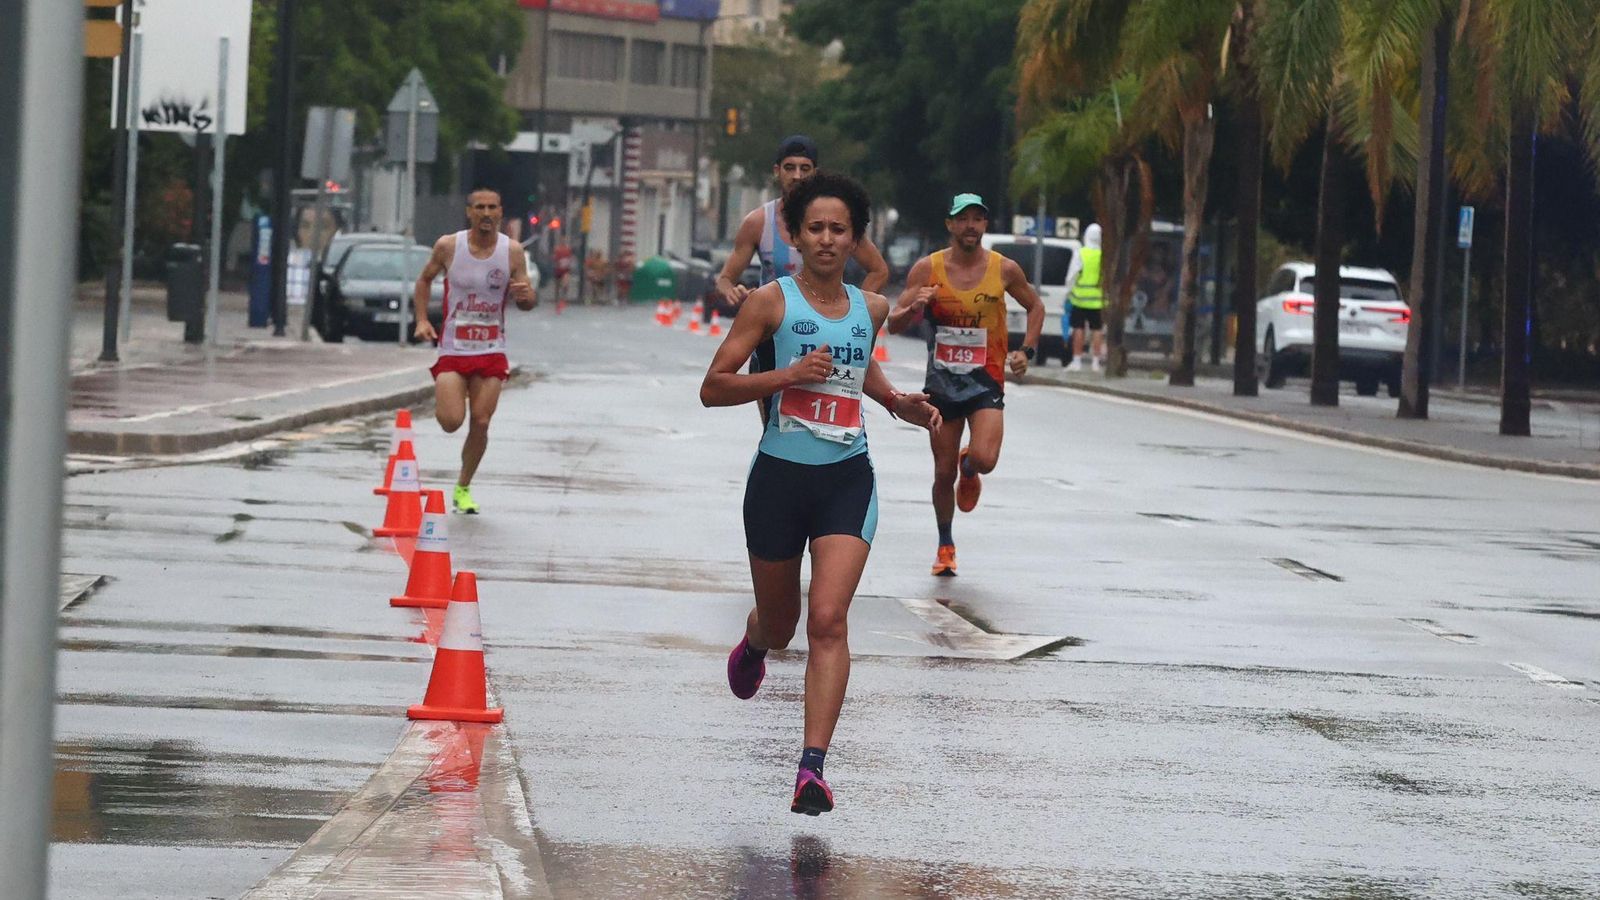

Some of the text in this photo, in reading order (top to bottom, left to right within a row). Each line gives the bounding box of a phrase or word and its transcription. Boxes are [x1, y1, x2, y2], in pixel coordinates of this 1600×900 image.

[466, 328, 490, 340] 179
[793, 322, 818, 334] TROPS
[946, 348, 974, 362] 149
[811, 399, 837, 422] 11
